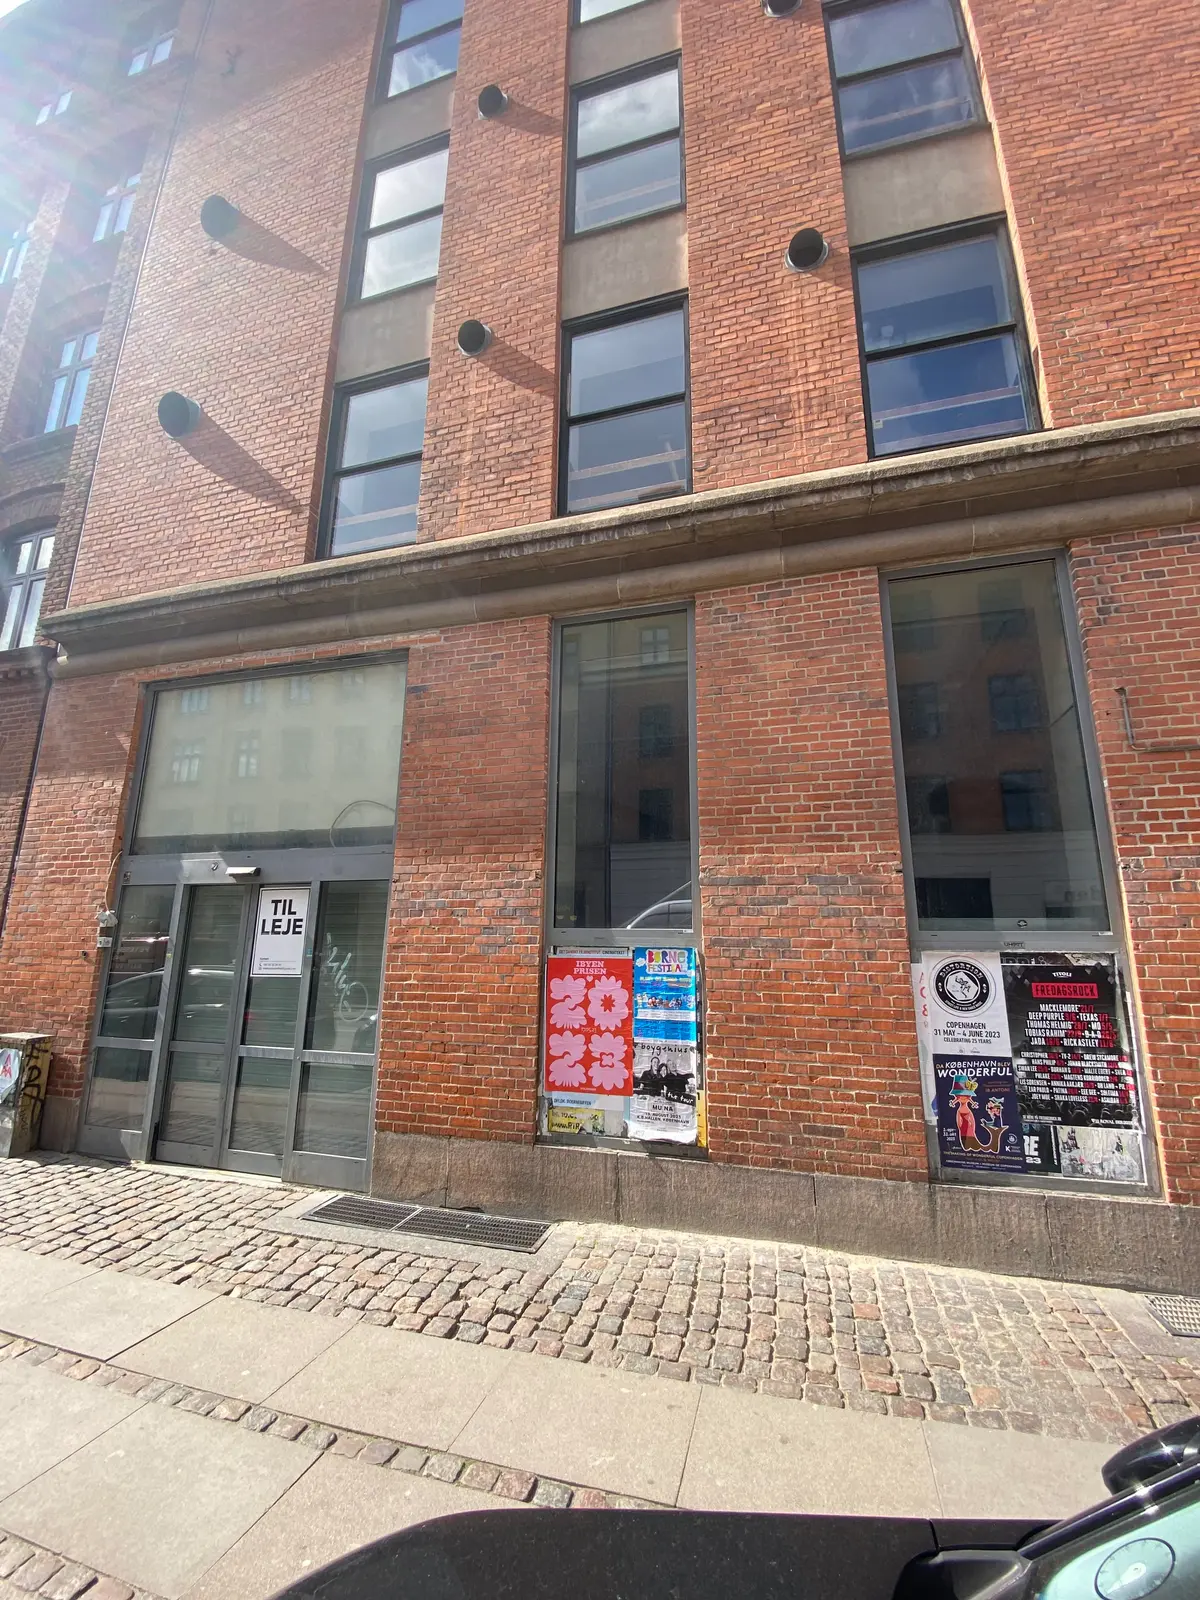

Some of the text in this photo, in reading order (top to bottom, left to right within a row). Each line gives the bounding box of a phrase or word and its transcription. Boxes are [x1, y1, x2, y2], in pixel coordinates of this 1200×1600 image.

[271, 899, 297, 915] TIL
[261, 918, 304, 935] LEJE
[1036, 983, 1096, 996] FREDAGSROCK
[1040, 1004, 1079, 1012] MACKLEMORE
[1029, 1012, 1043, 1020] DEEP
[1043, 1012, 1064, 1020] PURPLE
[1080, 1013, 1098, 1021] TEXAS
[946, 1021, 986, 1029] COPENHAGEN
[1027, 1020, 1050, 1028] THOMAS
[1051, 1021, 1072, 1029] HELMIG
[1025, 1028, 1046, 1036] TOBIAS
[1031, 1037, 1046, 1045] JADA
[1063, 1038, 1078, 1046] RICK
[1078, 1038, 1099, 1047] ASTLEY
[641, 1043, 688, 1056] boygenius
[938, 1067, 1013, 1078] WONDERFUL
